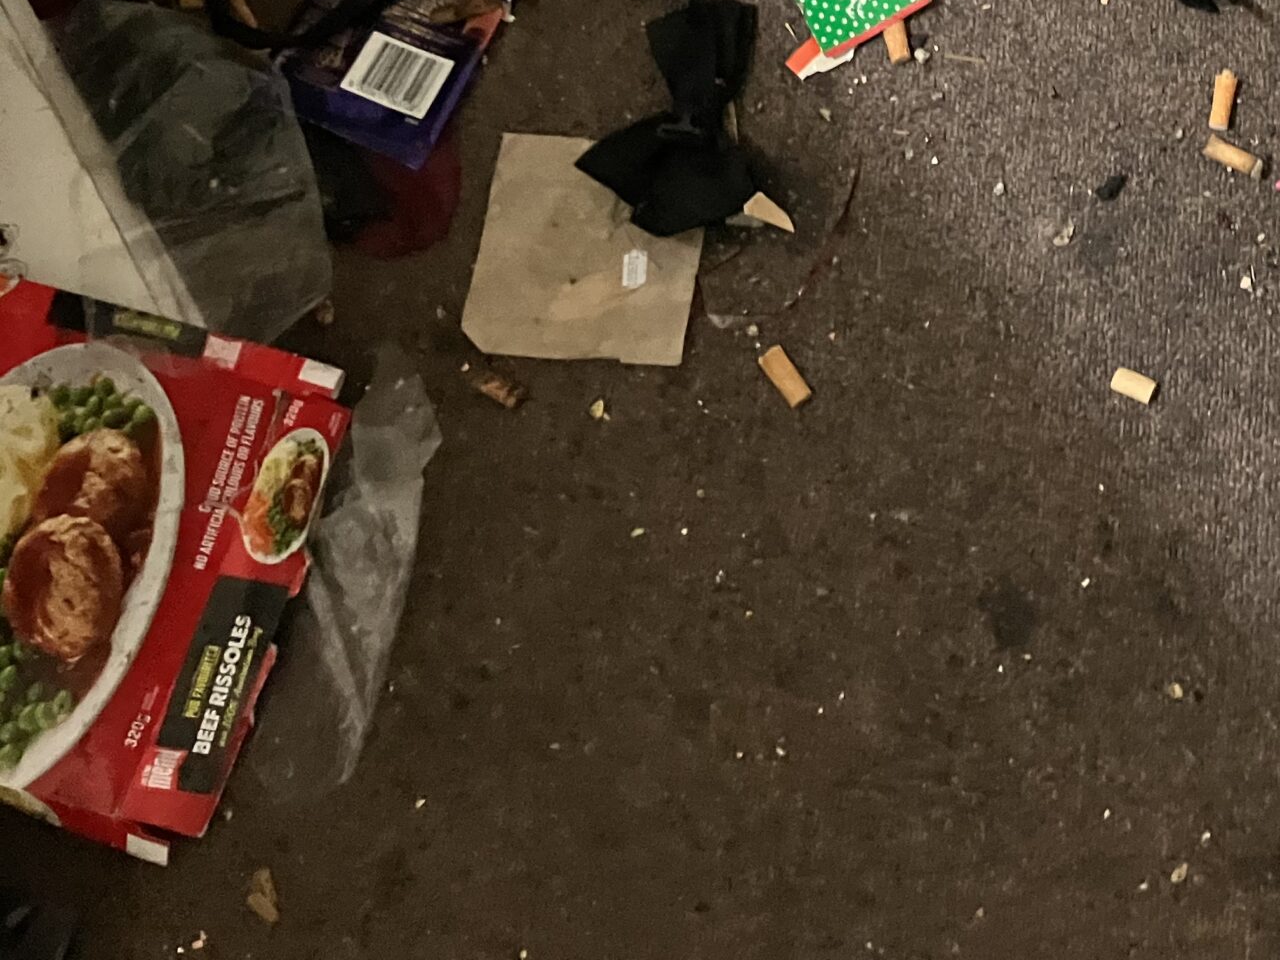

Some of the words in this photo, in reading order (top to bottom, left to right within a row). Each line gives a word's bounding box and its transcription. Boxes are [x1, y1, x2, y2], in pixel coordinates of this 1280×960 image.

[193, 553, 209, 571] NO
[236, 445, 250, 462] OR
[243, 398, 265, 447] FLAVOURS
[213, 449, 236, 487] SOURCE
[226, 435, 239, 449] OF
[124, 713, 152, 749] 320g
[192, 708, 221, 755] BEEF
[208, 614, 252, 707] RISSOLES
